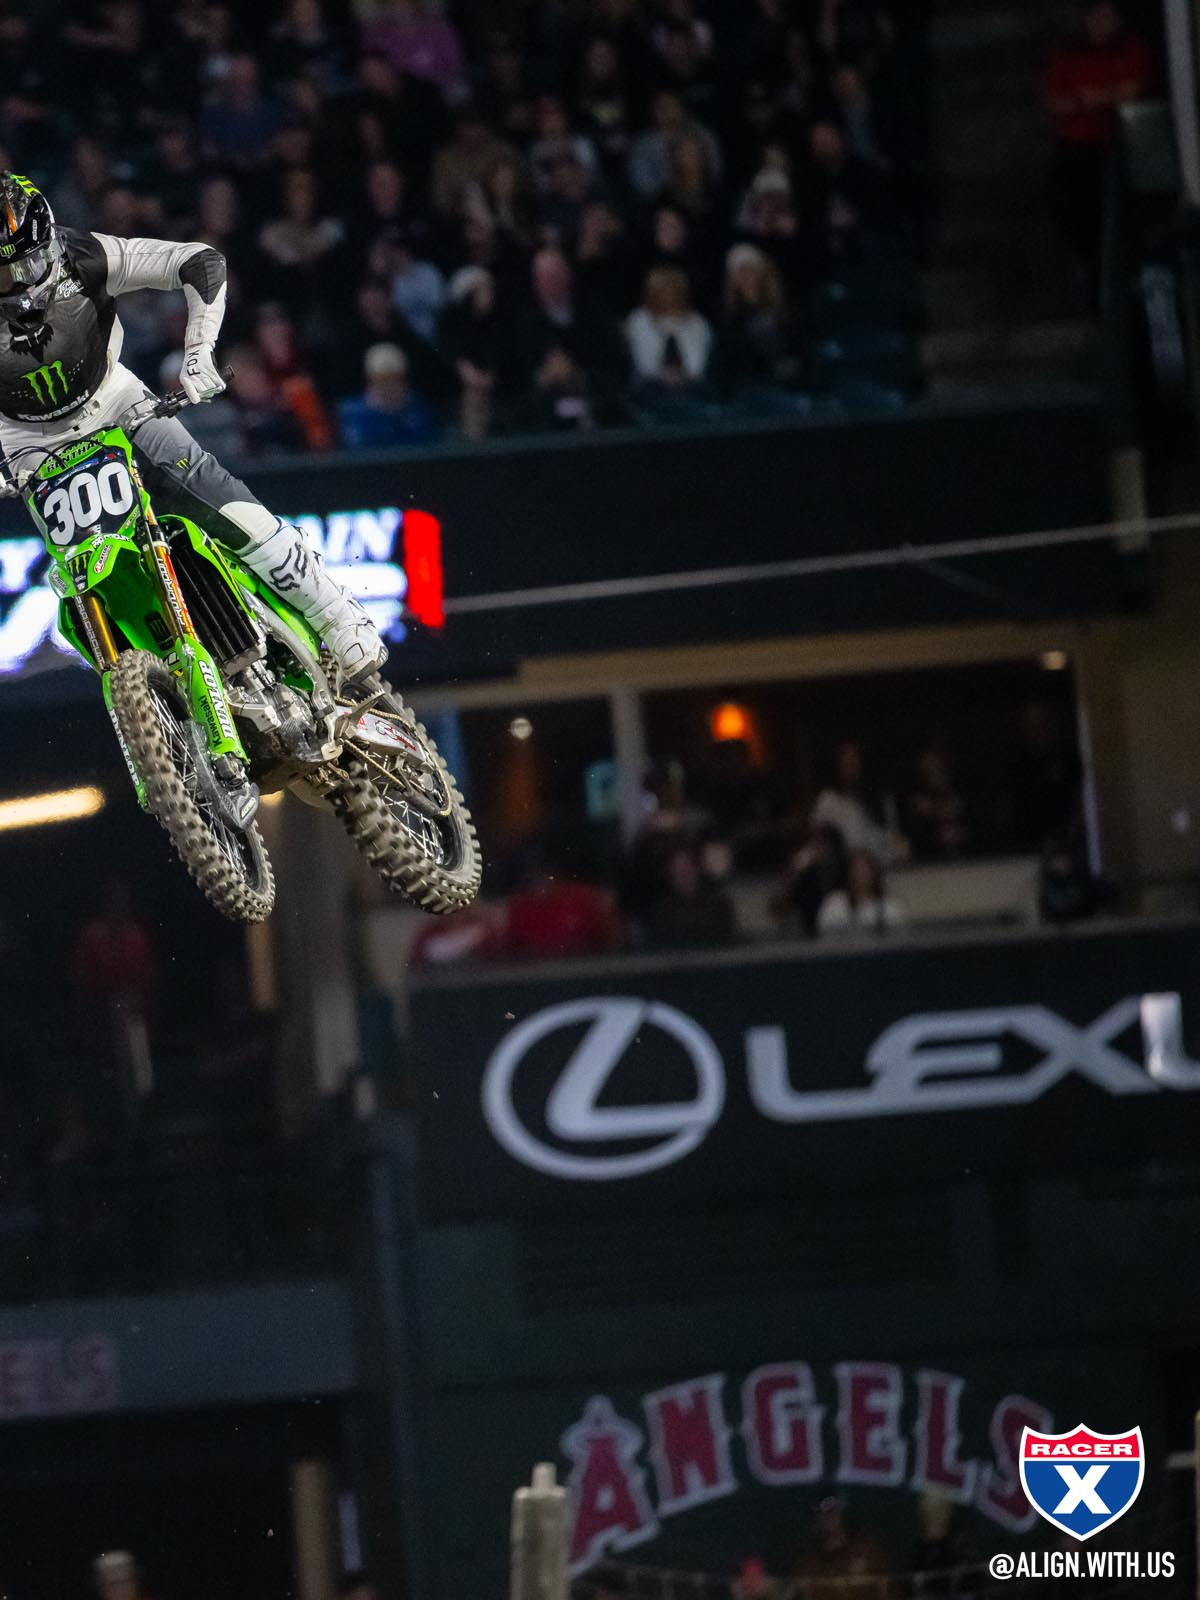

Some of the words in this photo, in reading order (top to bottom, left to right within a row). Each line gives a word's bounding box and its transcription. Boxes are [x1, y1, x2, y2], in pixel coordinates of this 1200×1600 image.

[186, 349, 200, 378] FOX
[17, 389, 89, 421] Kawasaki
[43, 461, 134, 546] 300
[199, 660, 236, 740] DUNLOP
[200, 695, 222, 748] Kawasaki
[108, 709, 140, 786] DUNLOP
[561, 1361, 1054, 1577] ANGELS
